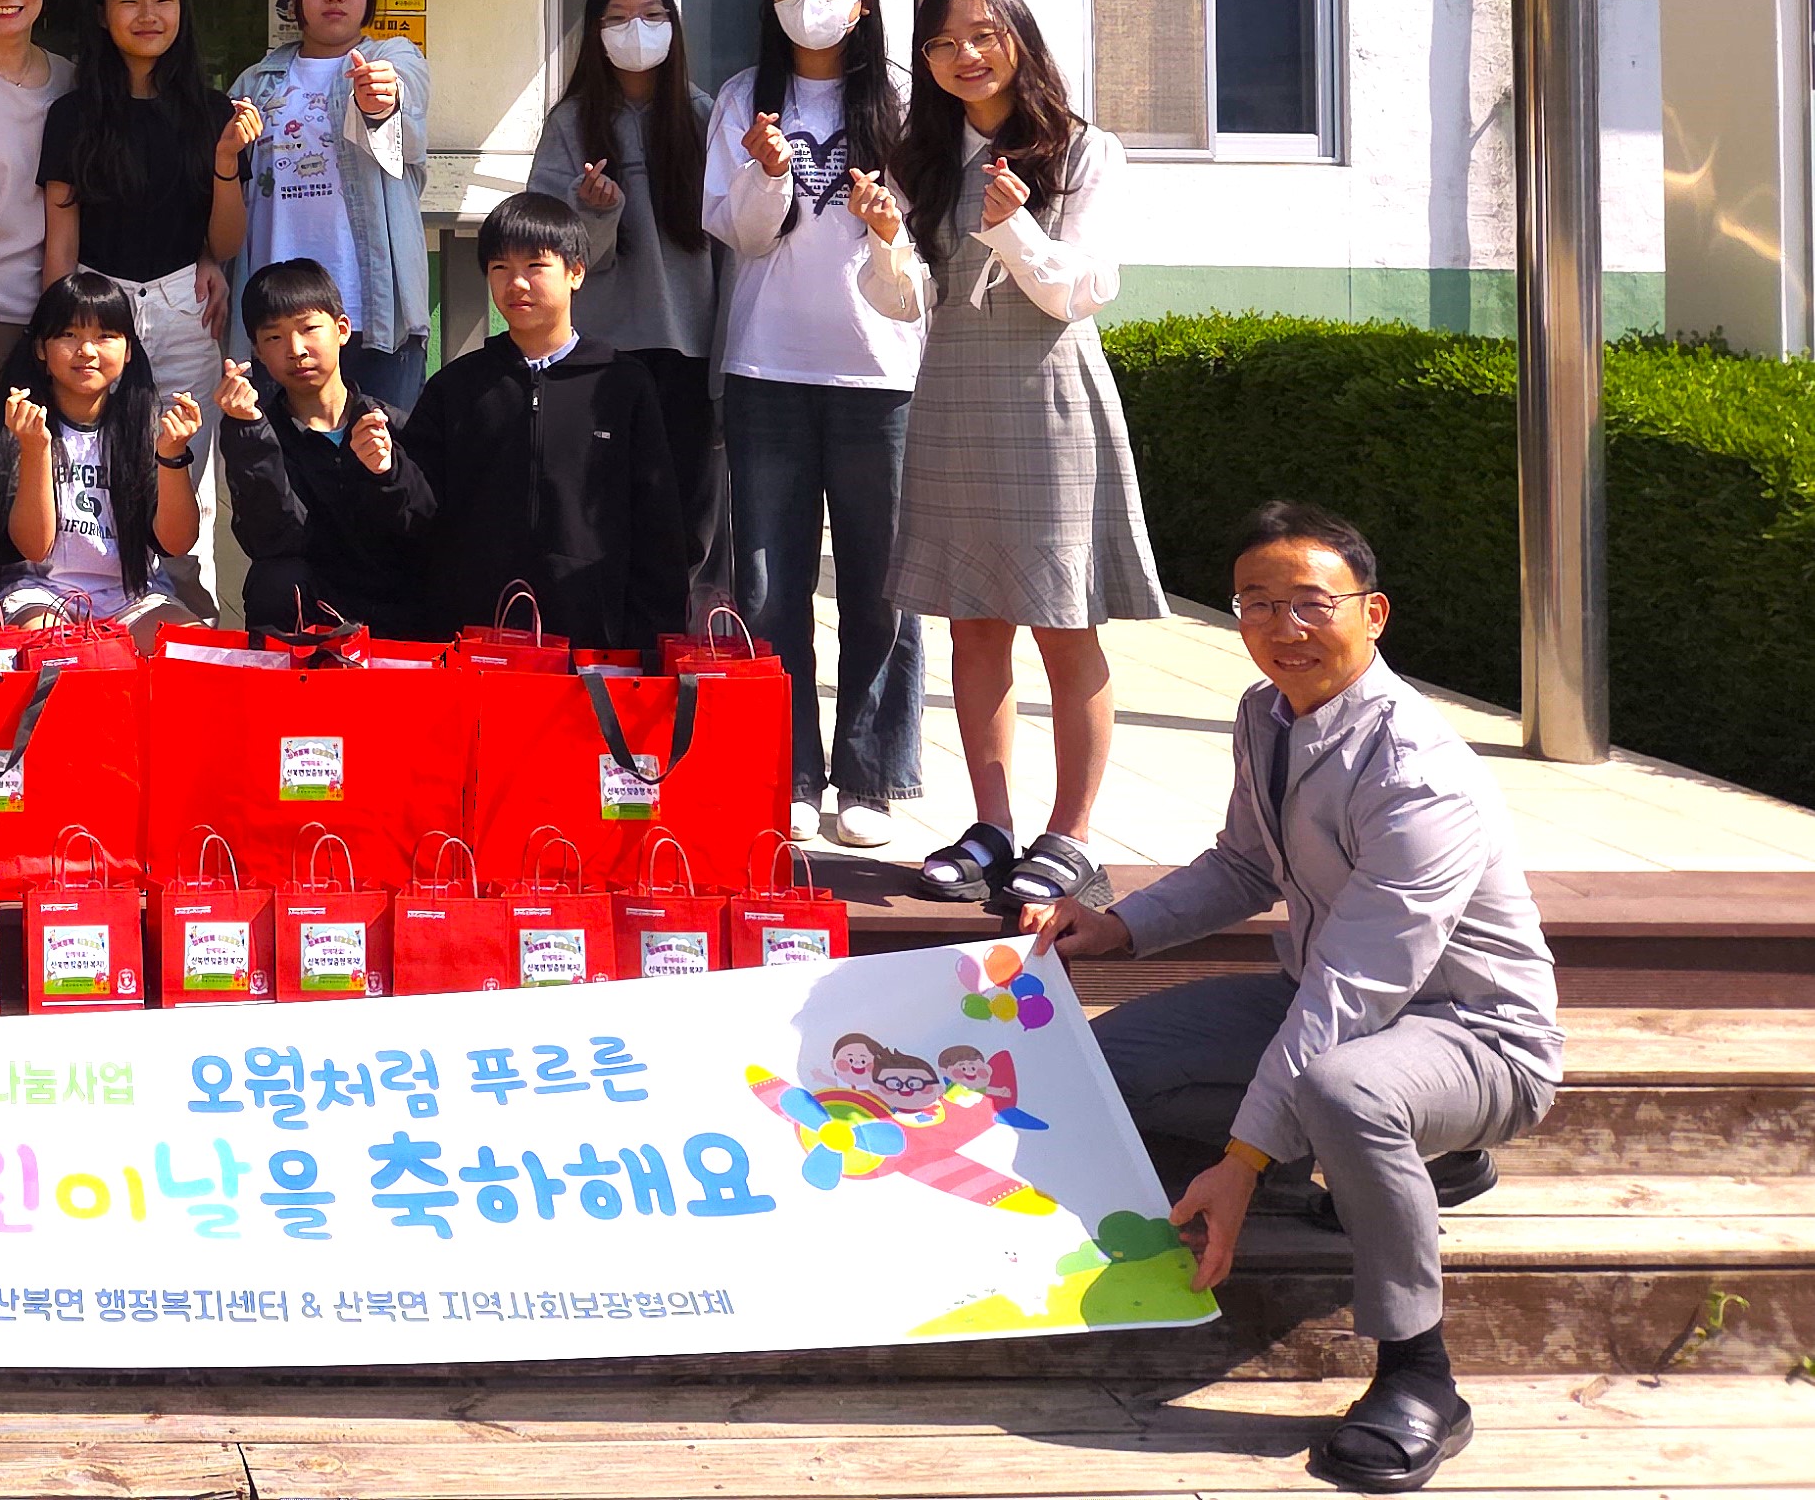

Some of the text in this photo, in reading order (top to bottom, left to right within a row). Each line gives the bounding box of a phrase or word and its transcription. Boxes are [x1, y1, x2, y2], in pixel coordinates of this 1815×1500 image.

[188, 1036, 648, 1130] 오월처럼 푸르른
[368, 1131, 776, 1239] 축하해요
[96, 1289, 288, 1322] 행정복지센터
[302, 1292, 320, 1316] &
[337, 1291, 426, 1322] 산북면
[442, 1291, 733, 1320] 지역사회보장협의체
